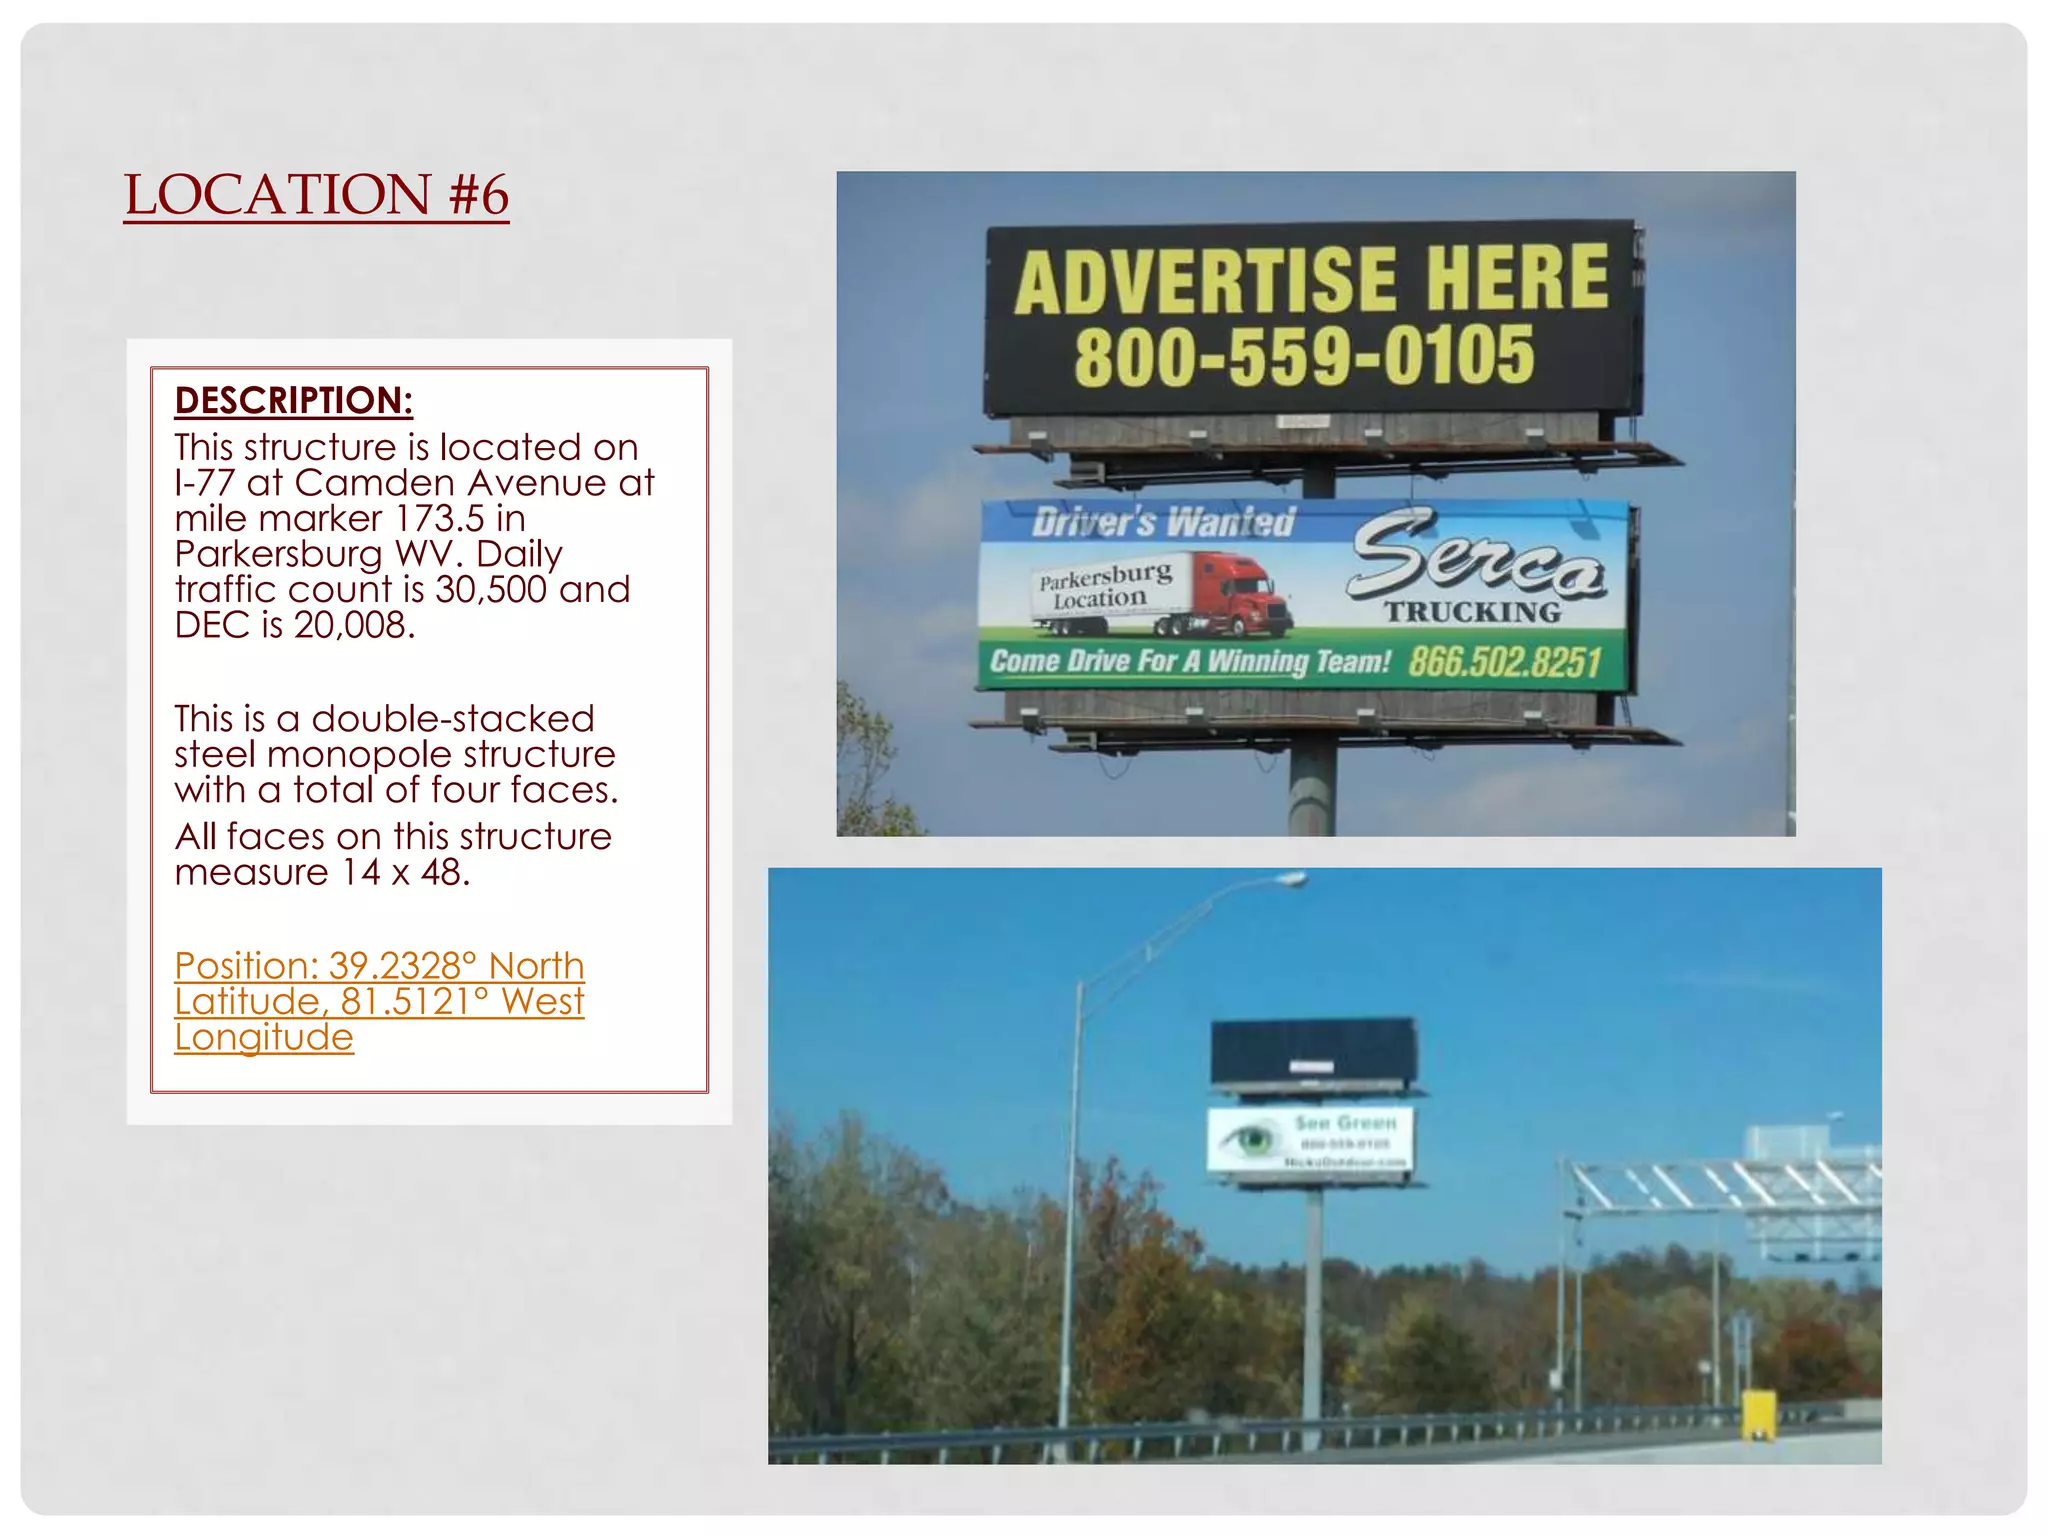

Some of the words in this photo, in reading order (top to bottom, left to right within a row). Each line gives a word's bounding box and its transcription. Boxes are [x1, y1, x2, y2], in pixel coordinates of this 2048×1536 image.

[1014, 246, 1397, 315] ADVERTISE
[1427, 242, 1609, 310] HERE
[1075, 323, 1535, 388] 800-559-0105
[1031, 503, 1157, 538] Driver's
[1166, 504, 1298, 538] Wanted
[1040, 563, 1174, 592] Parkersburg
[1053, 589, 1148, 611] Location
[1384, 600, 1563, 624] TRUCKING
[990, 648, 1060, 673] Come
[1067, 650, 1130, 672] Drive
[1137, 650, 1178, 672] For
[1182, 650, 1201, 673] A
[1208, 650, 1311, 679] Winning
[1317, 650, 1392, 674] Team!
[1409, 645, 1602, 679] 866.502.8251
